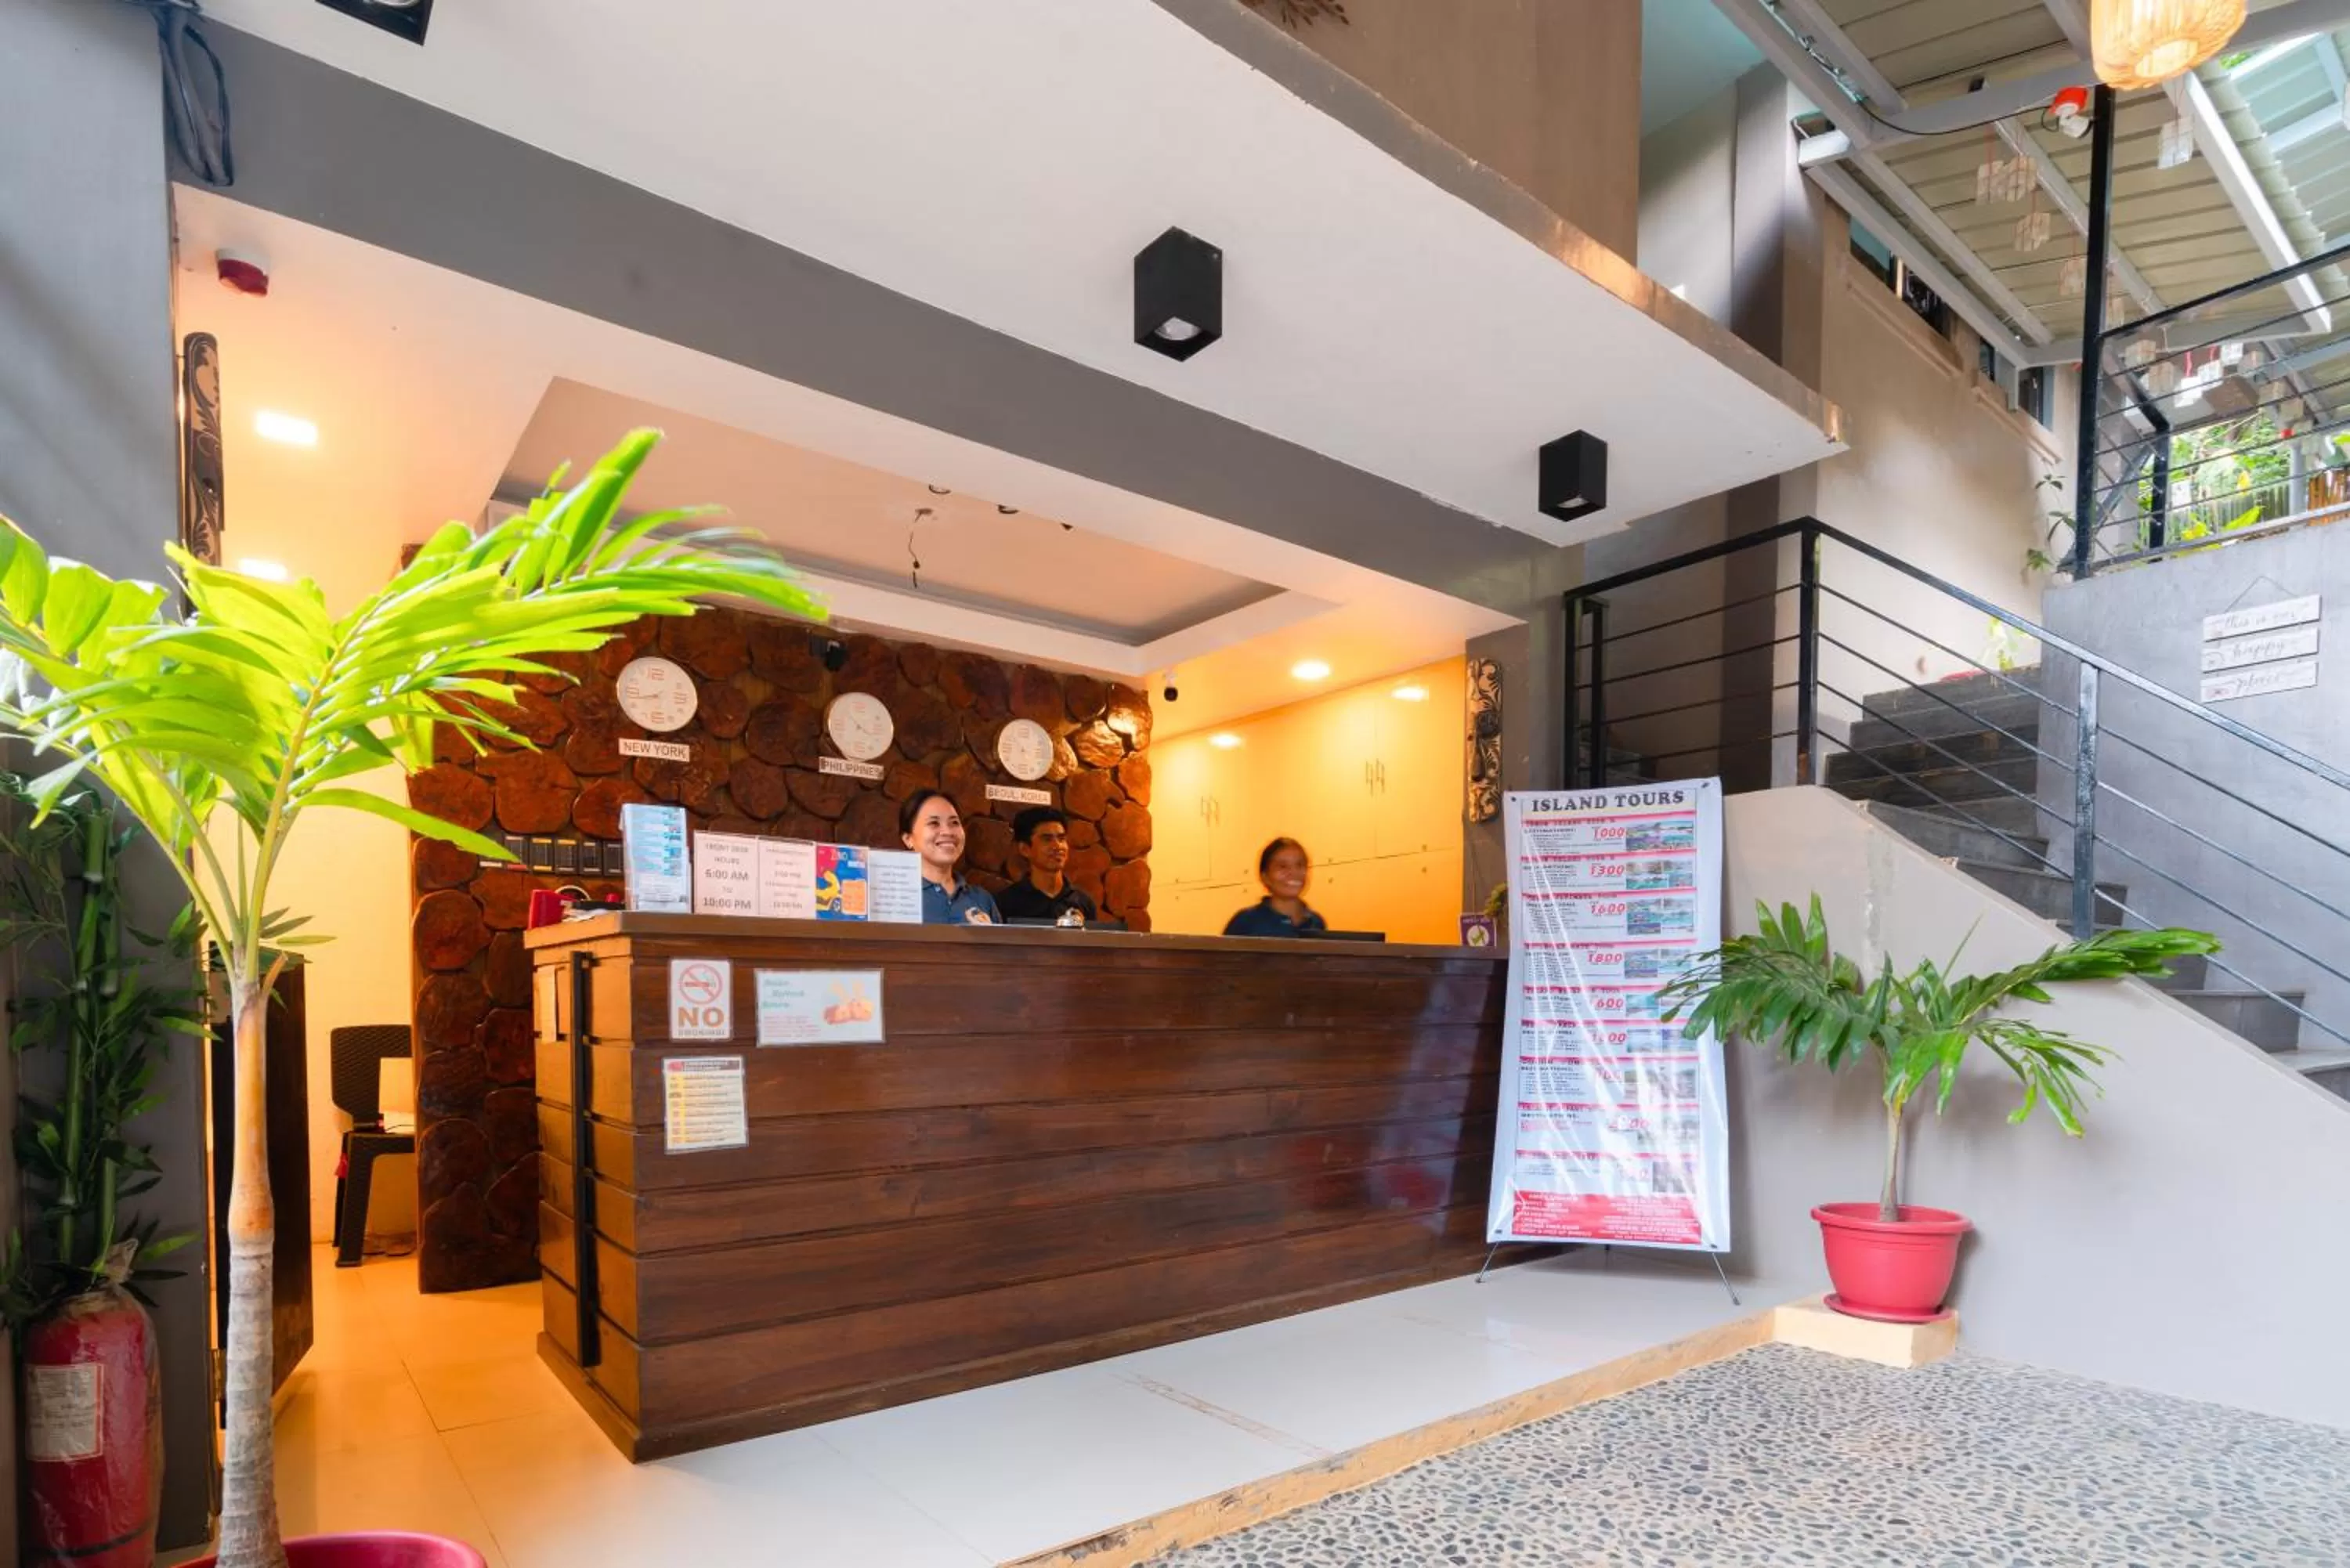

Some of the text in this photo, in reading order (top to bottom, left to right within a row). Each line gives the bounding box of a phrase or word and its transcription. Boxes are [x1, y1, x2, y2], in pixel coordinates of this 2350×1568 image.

[624, 742, 687, 758] NEW YORK
[1531, 790, 1684, 812] ISLAND TOURS
[730, 870, 749, 881] AM
[734, 899, 751, 909] PM
[678, 1006, 725, 1028] NO
